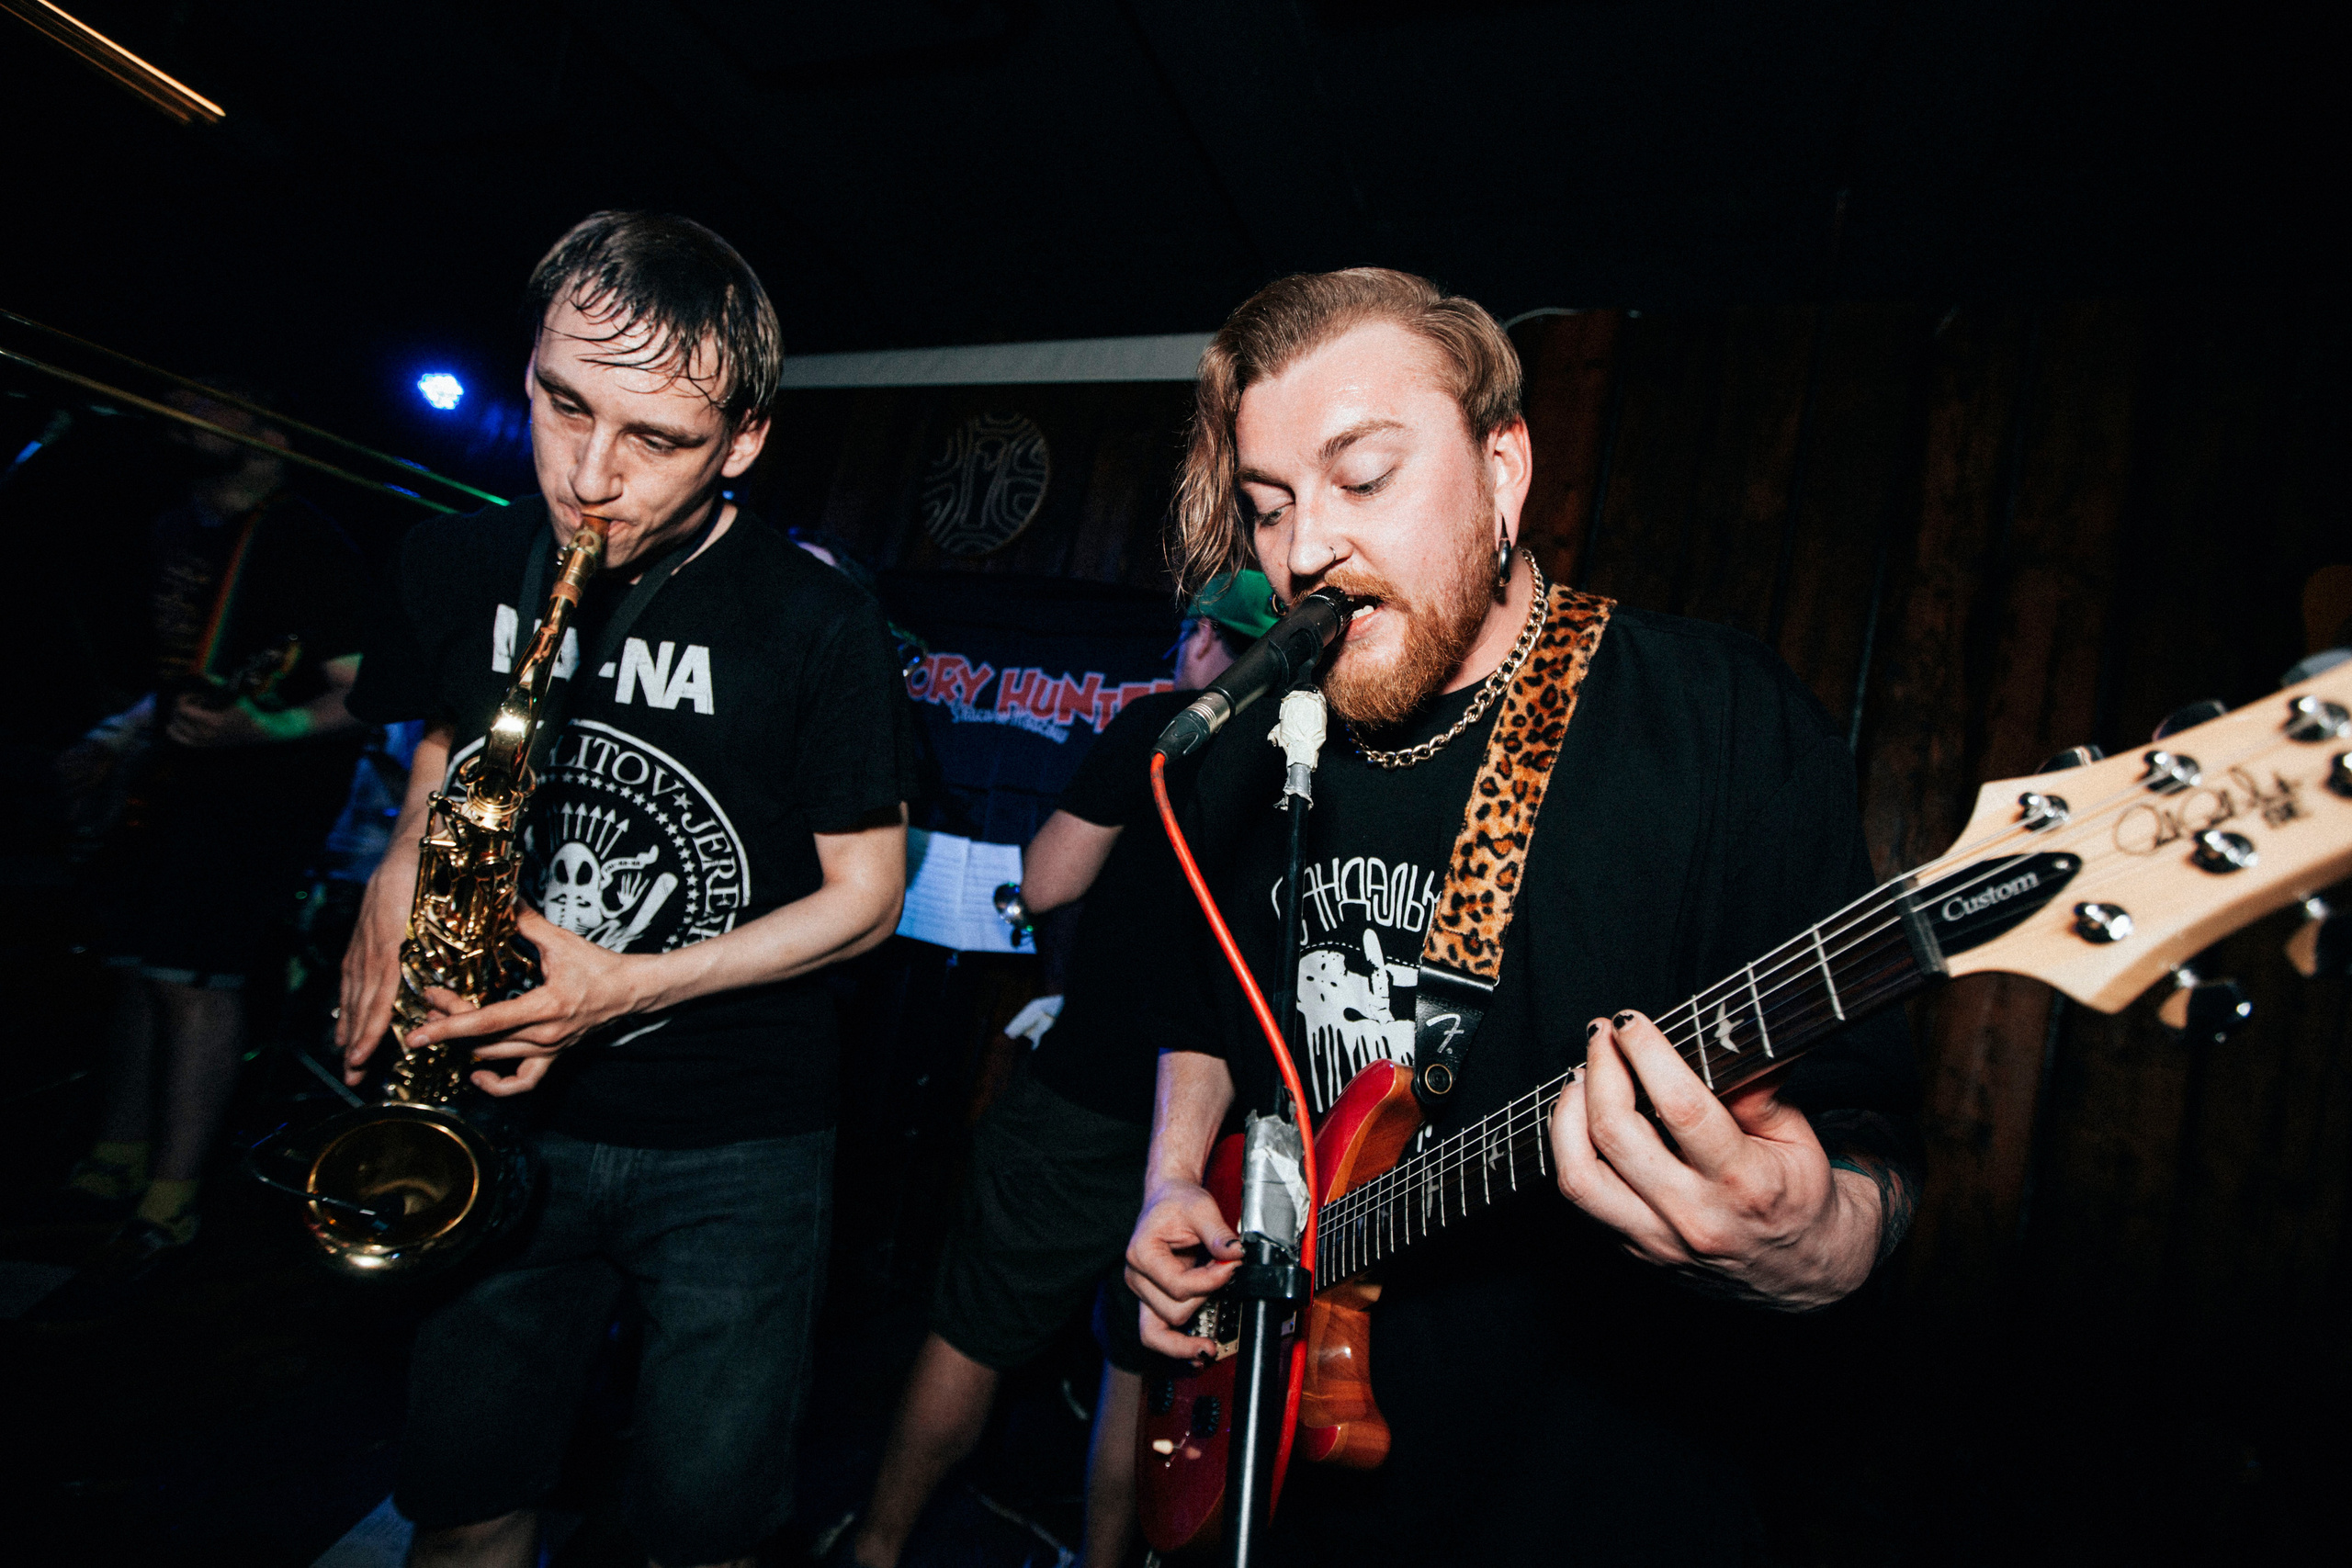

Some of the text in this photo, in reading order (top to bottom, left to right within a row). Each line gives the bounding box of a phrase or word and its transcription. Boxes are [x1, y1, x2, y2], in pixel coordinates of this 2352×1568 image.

[906, 652, 995, 705] ORY
[996, 667, 1175, 733] HUNT
[548, 734, 686, 796] LITOV
[1941, 871, 2040, 921] Custom
